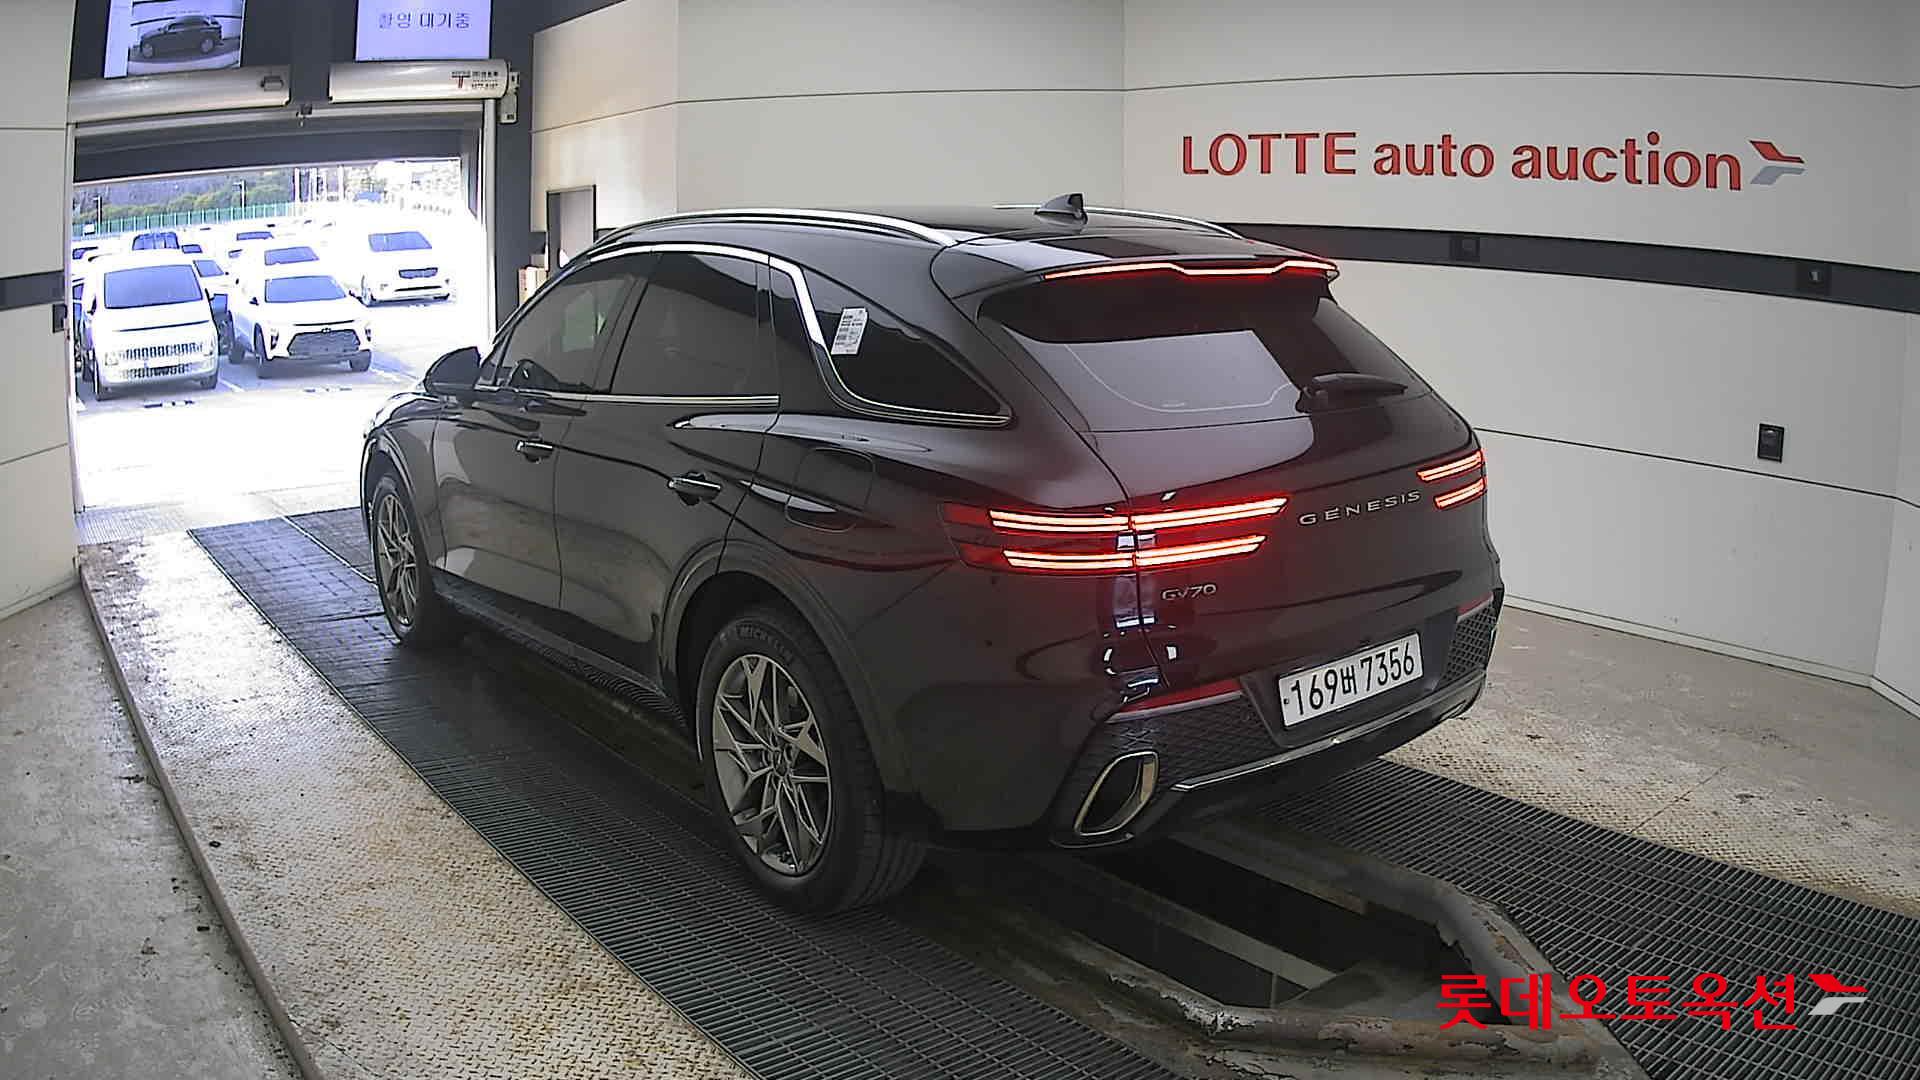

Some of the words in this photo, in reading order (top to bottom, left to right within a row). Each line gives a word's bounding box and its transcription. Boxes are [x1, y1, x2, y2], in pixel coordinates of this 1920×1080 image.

[1182, 131, 1357, 176] LOTTE
[1374, 134, 1495, 178] auto
[1511, 131, 1742, 191] auction
[1299, 489, 1421, 525] GENESIS
[1161, 584, 1217, 601] GV70
[1359, 641, 1415, 692] 7356
